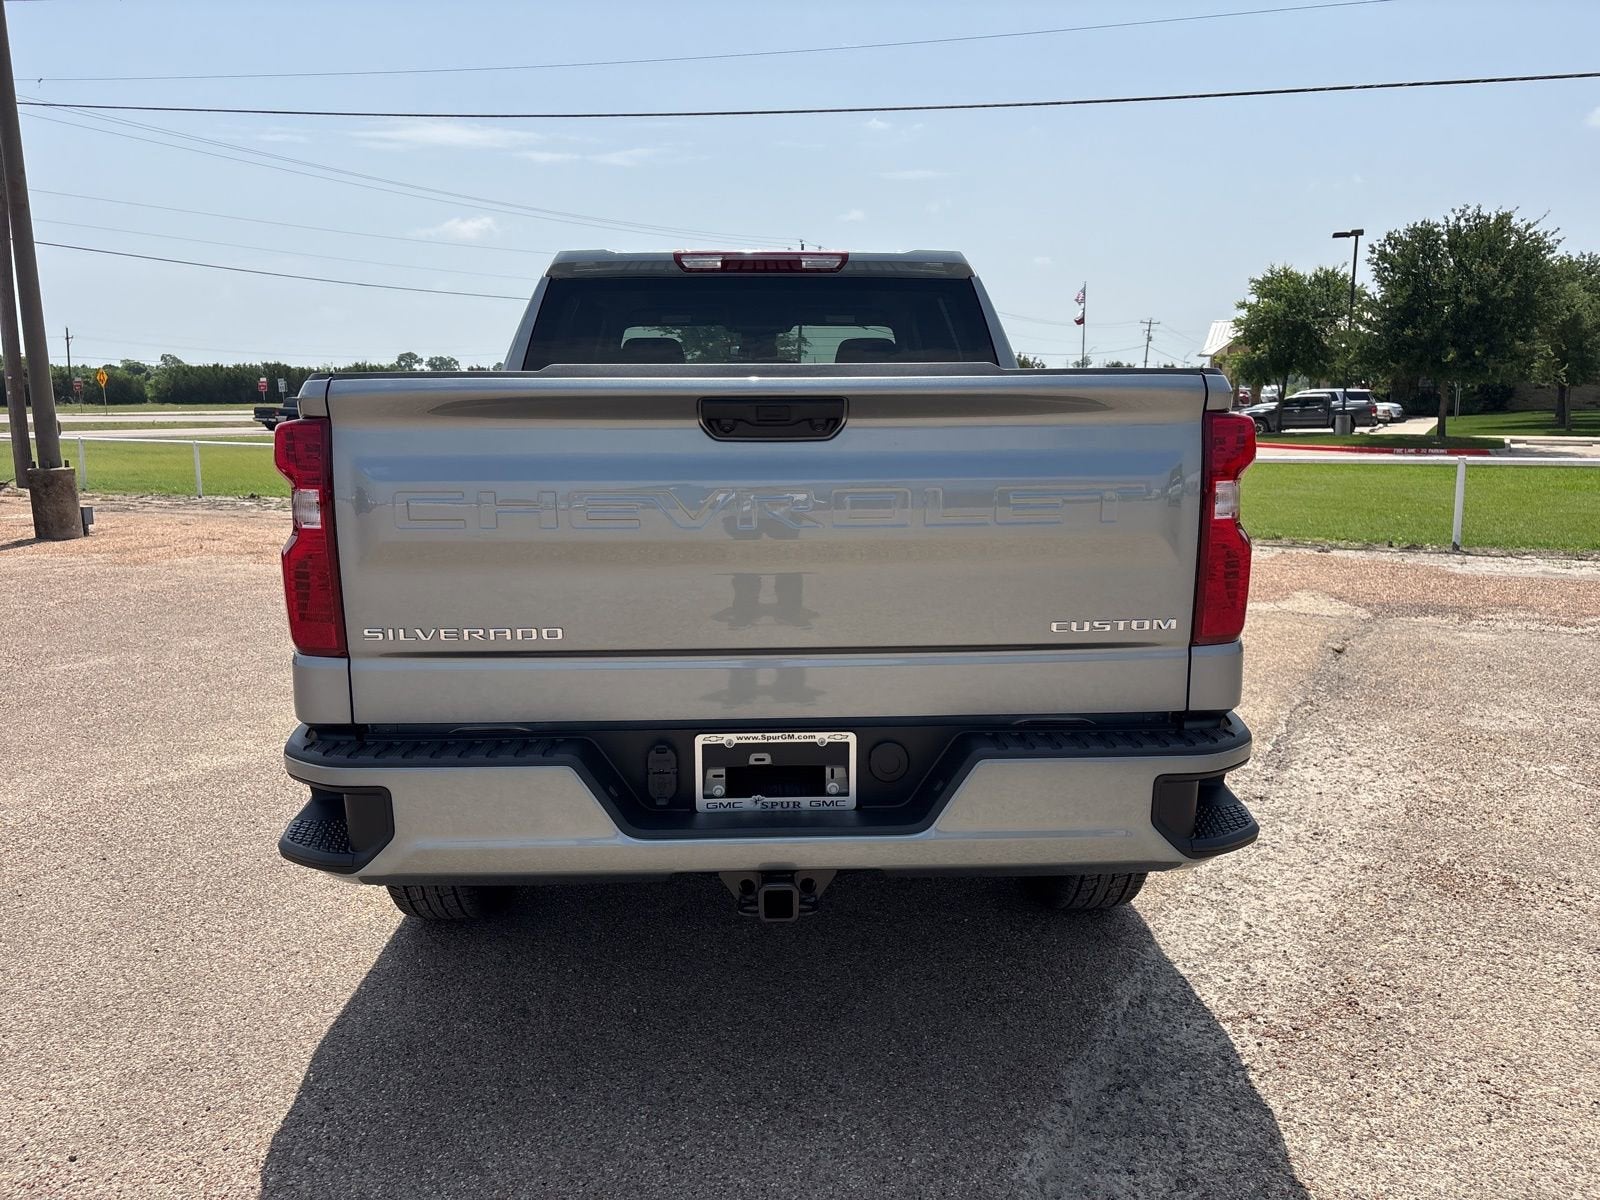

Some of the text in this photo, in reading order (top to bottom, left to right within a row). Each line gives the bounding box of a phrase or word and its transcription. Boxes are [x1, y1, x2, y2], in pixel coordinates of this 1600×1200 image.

[393, 484, 1149, 530] CHEVROLET
[1050, 618, 1177, 632] CUSTOM
[363, 628, 564, 640] SILVERADO
[736, 733, 816, 742] www.SpurGM.com
[706, 801, 743, 810] GMC
[760, 801, 802, 810] SPUR
[809, 800, 846, 808] GMC
